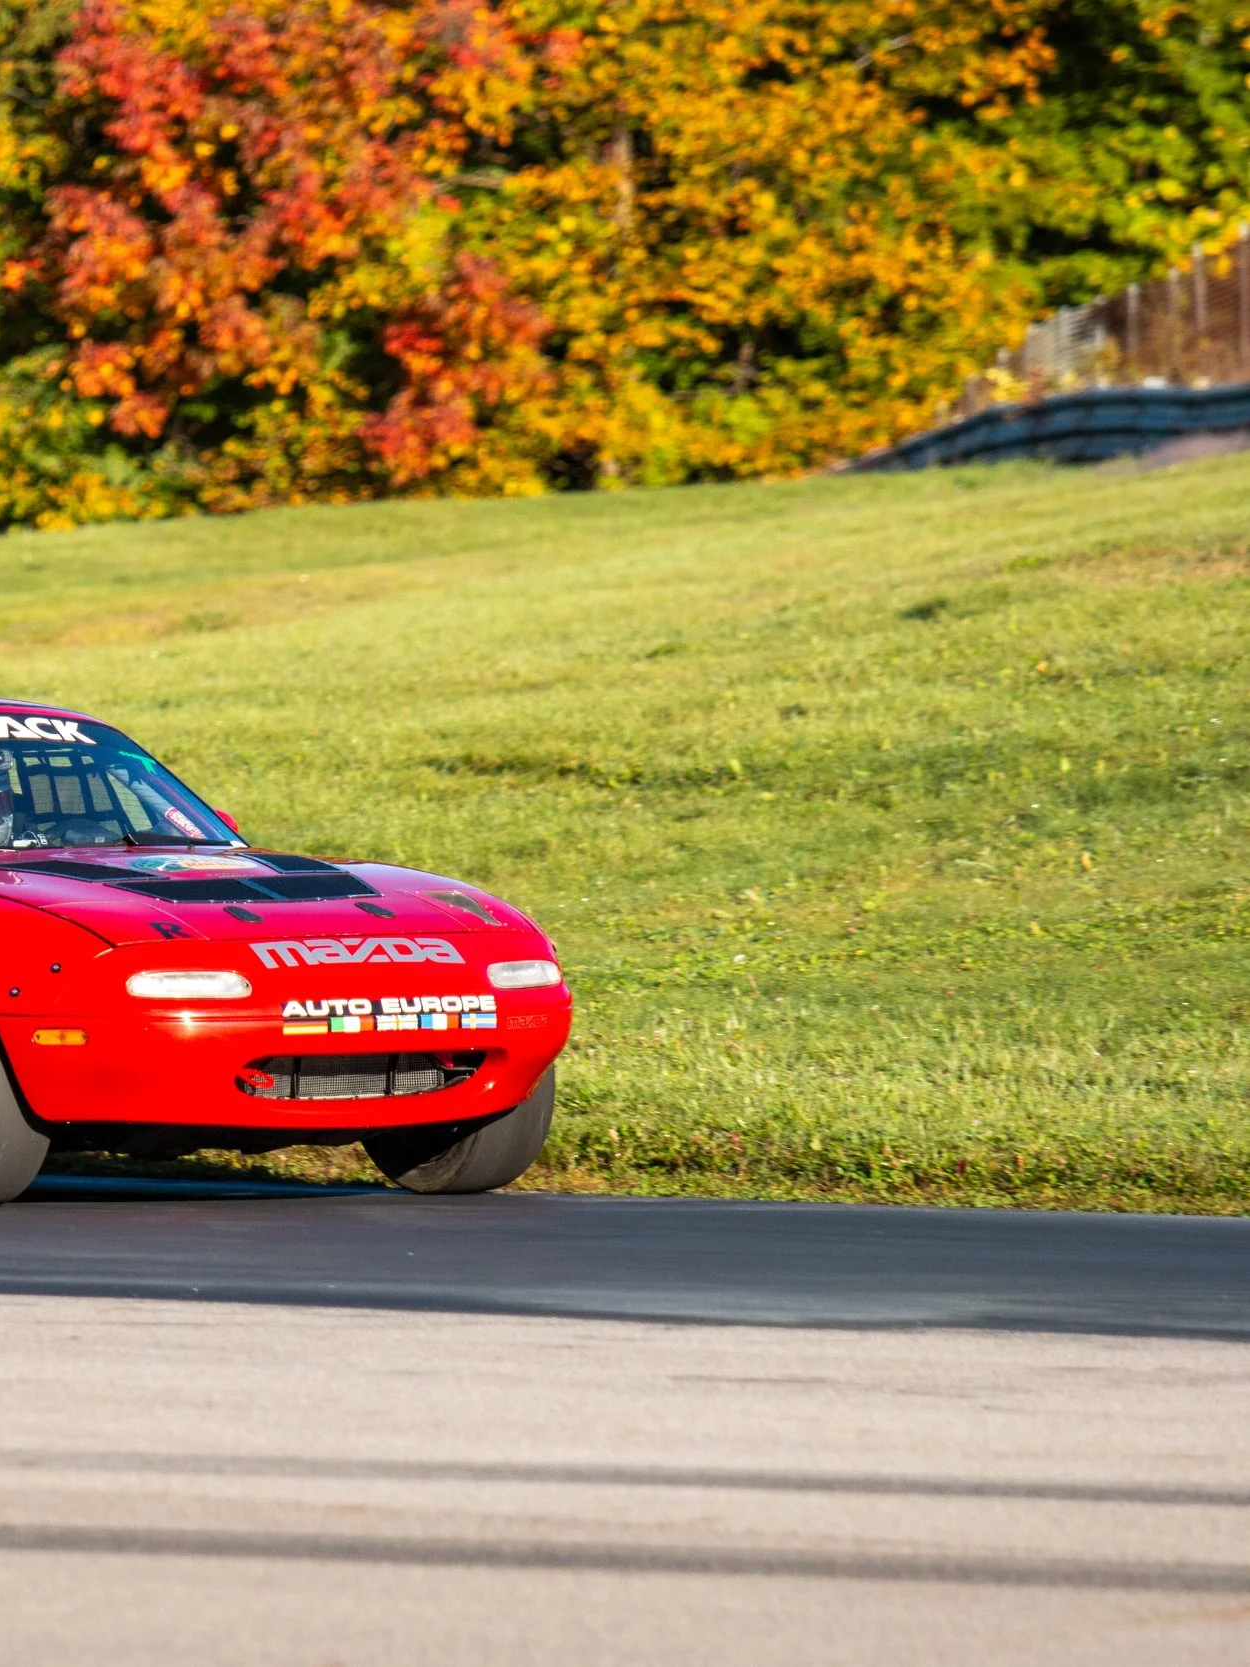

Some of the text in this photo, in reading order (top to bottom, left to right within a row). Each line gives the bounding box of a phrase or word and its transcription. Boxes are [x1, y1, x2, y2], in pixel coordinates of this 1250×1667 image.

[148, 921, 193, 940] R
[283, 995, 496, 1017] AUTO EUROPE
